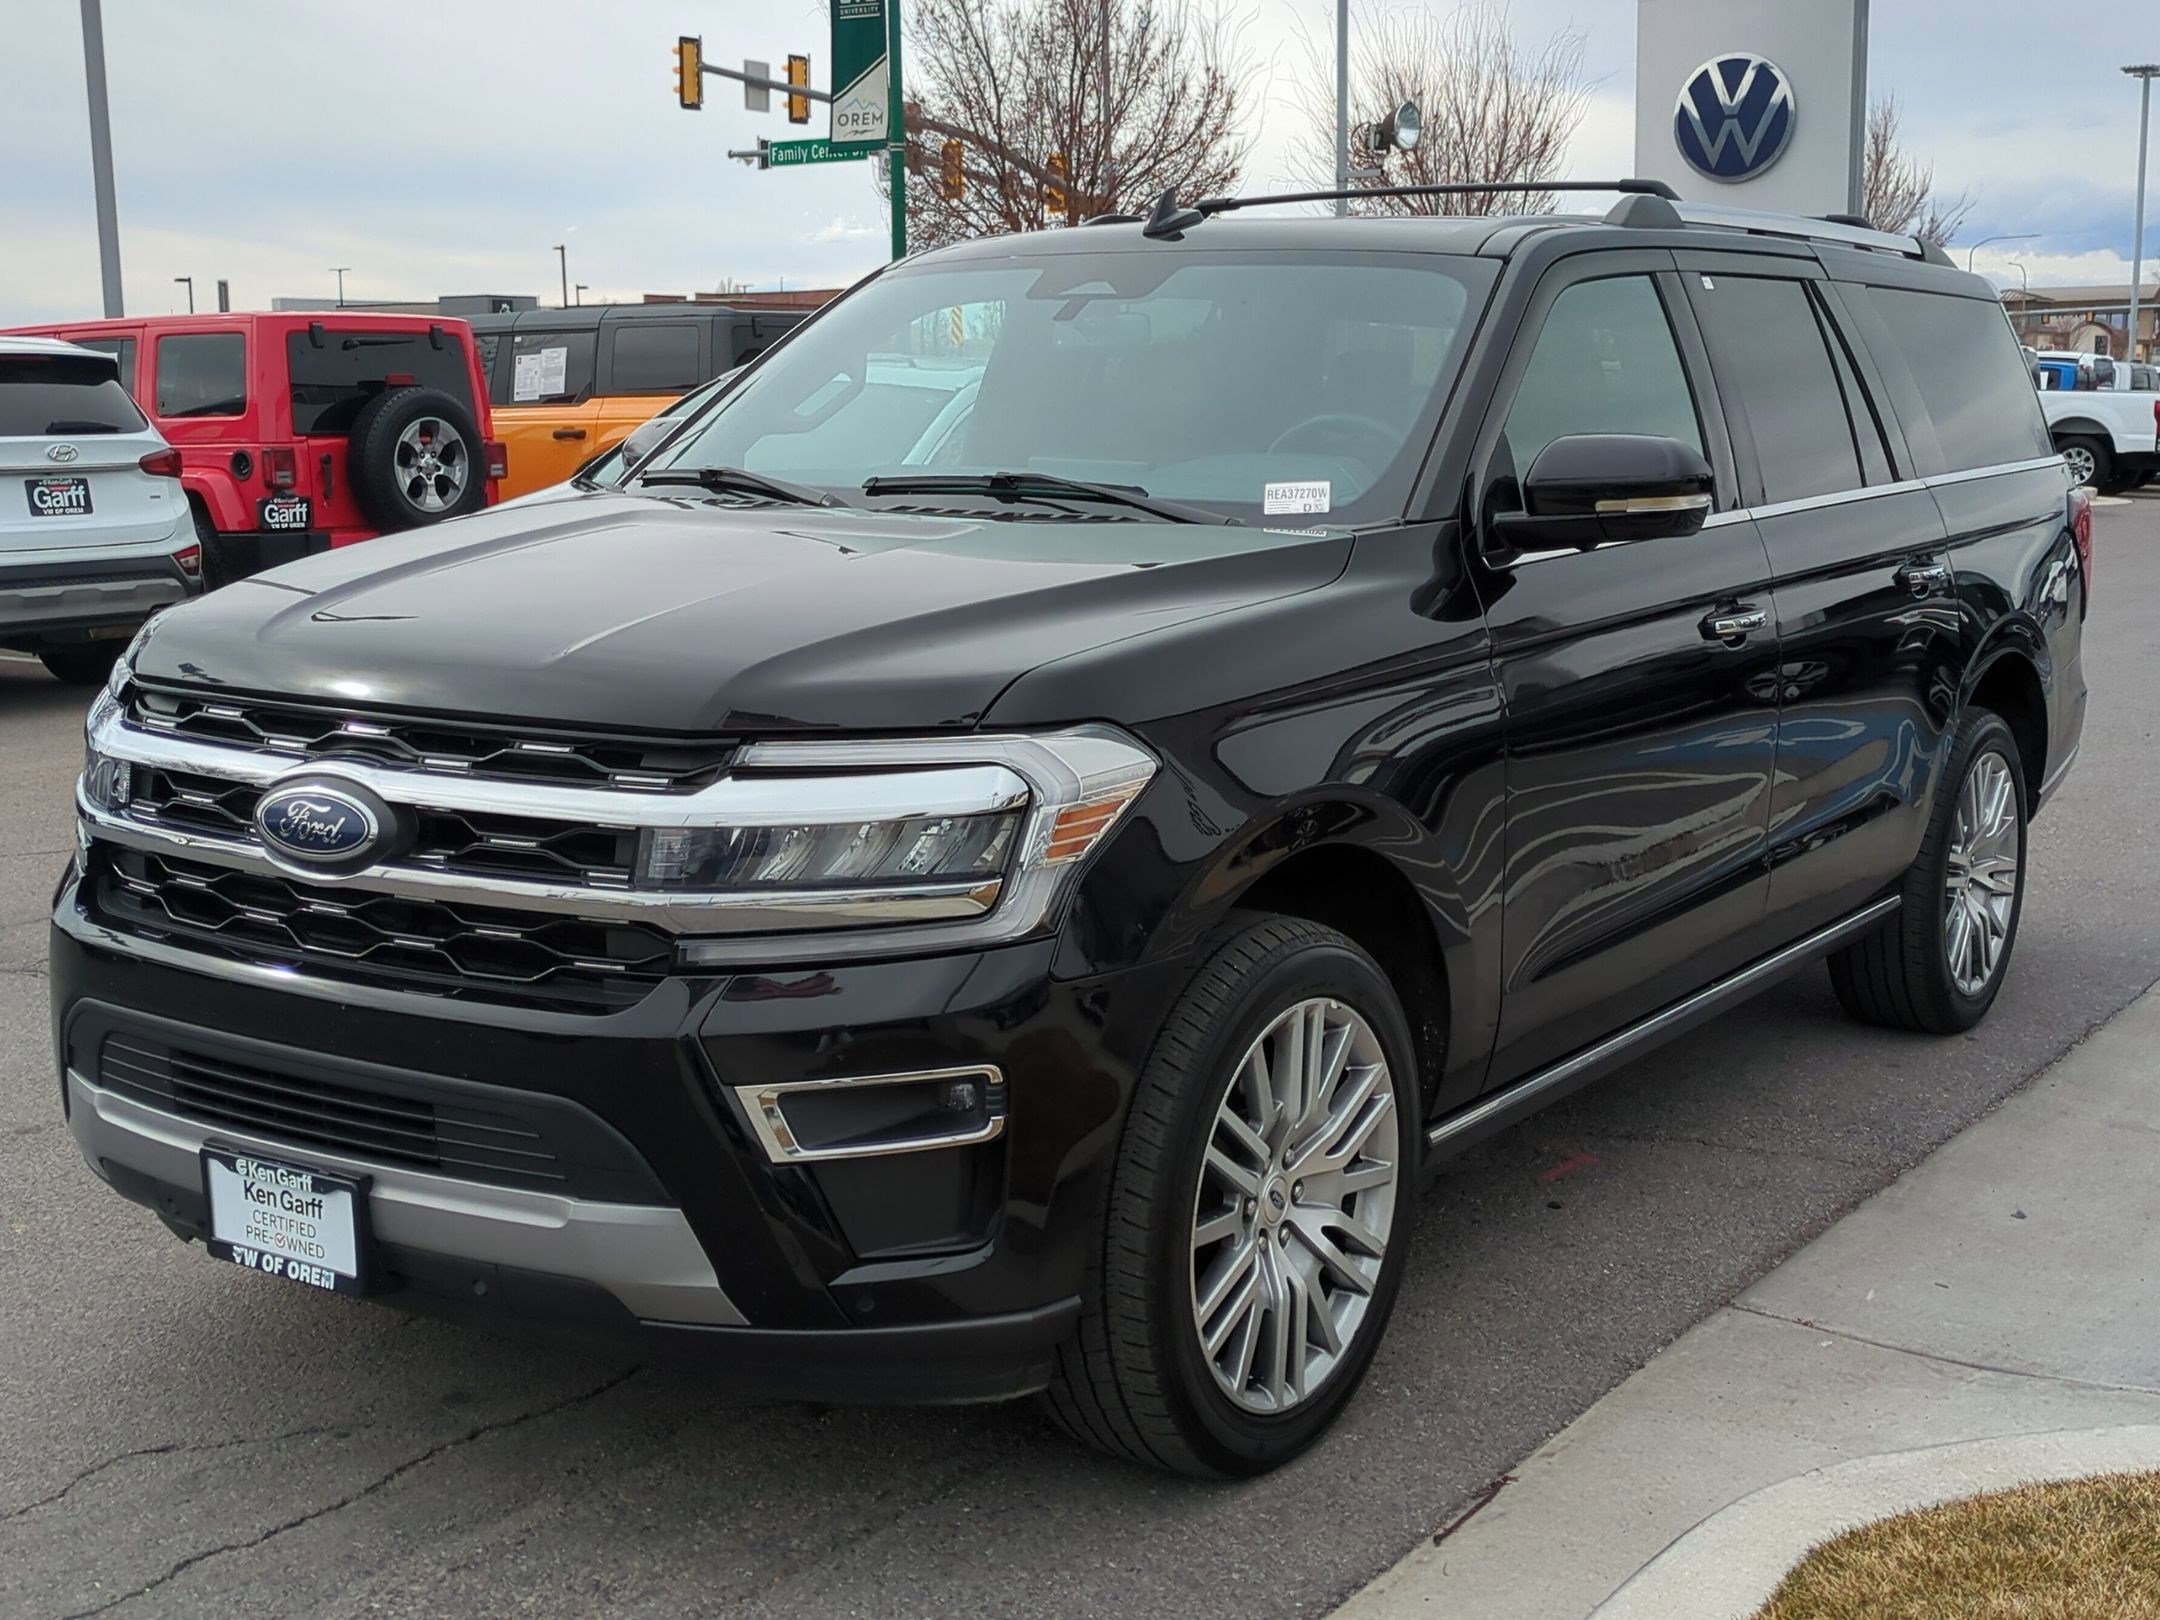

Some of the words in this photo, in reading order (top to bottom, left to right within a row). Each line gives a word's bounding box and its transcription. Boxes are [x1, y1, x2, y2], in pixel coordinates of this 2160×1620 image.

[840, 6, 879, 15] UNIVERSITY
[837, 111, 884, 127] OREM
[771, 145, 808, 163] Family
[33, 485, 86, 509] Garff
[1267, 487, 1327, 500] REA37270W
[264, 503, 308, 524] Garff
[279, 800, 346, 844] Ford
[244, 1180, 277, 1208] Ken
[281, 1190, 323, 1220] Garff
[252, 1209, 317, 1239] CERTIFIED
[262, 1254, 284, 1275] OF
[287, 1261, 335, 1291] OREM
